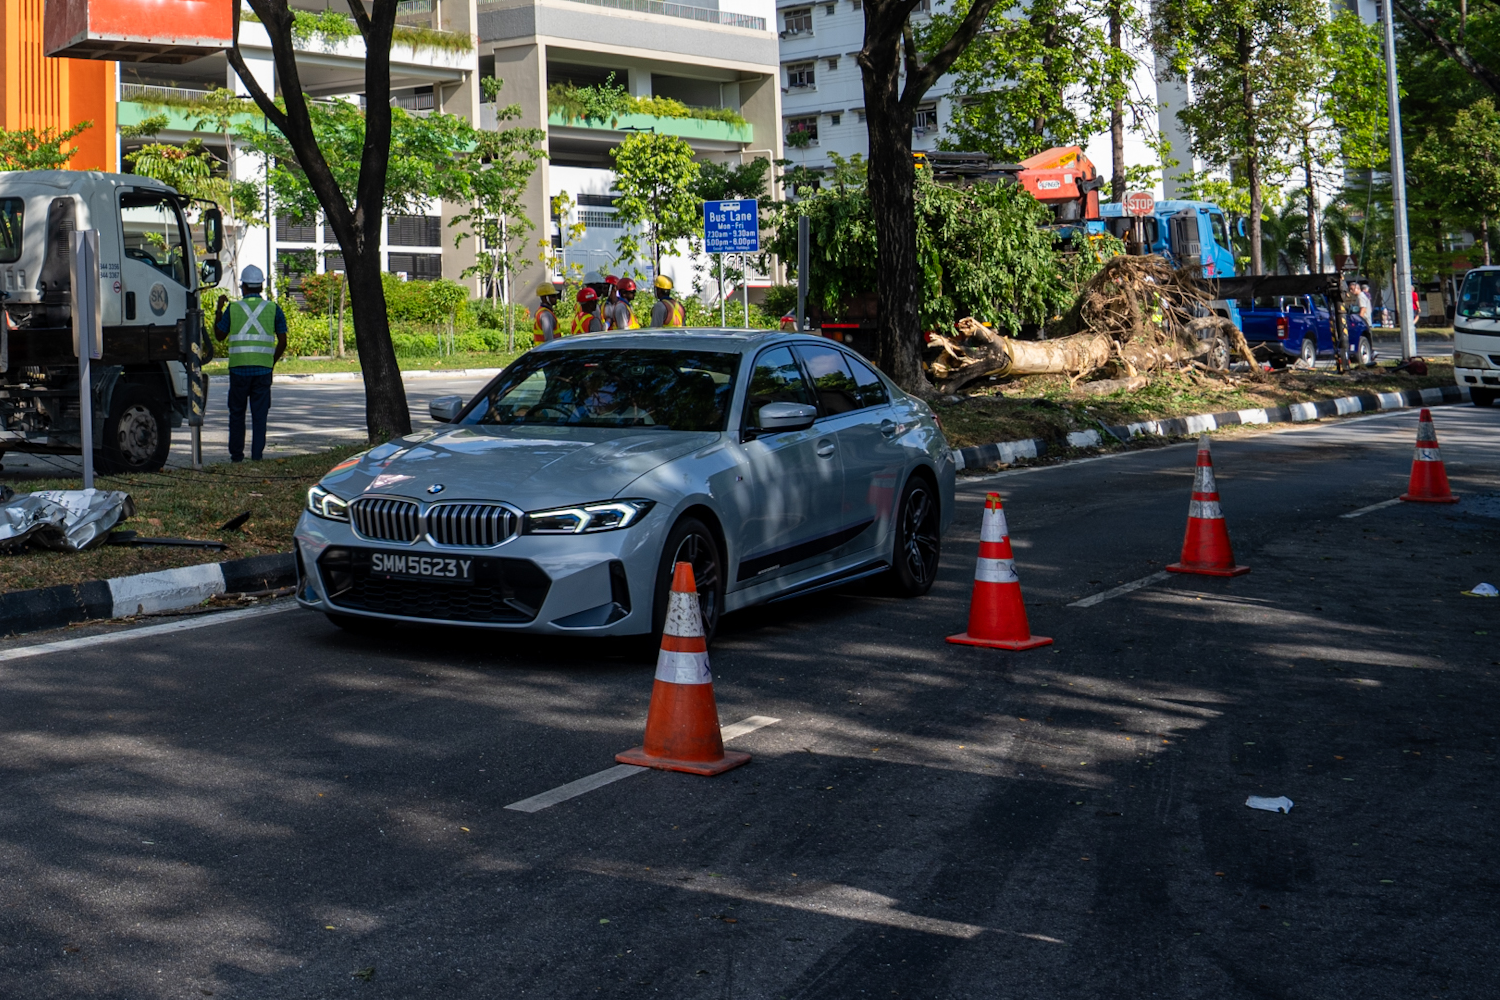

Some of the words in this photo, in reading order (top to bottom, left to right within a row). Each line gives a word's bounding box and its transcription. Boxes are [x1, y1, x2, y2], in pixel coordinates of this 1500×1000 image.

[1129, 198, 1153, 210] STOP
[709, 211, 726, 222] Bus
[730, 211, 752, 221] Lane
[151, 290, 164, 302] SK
[372, 553, 472, 578] SMM5623Y
